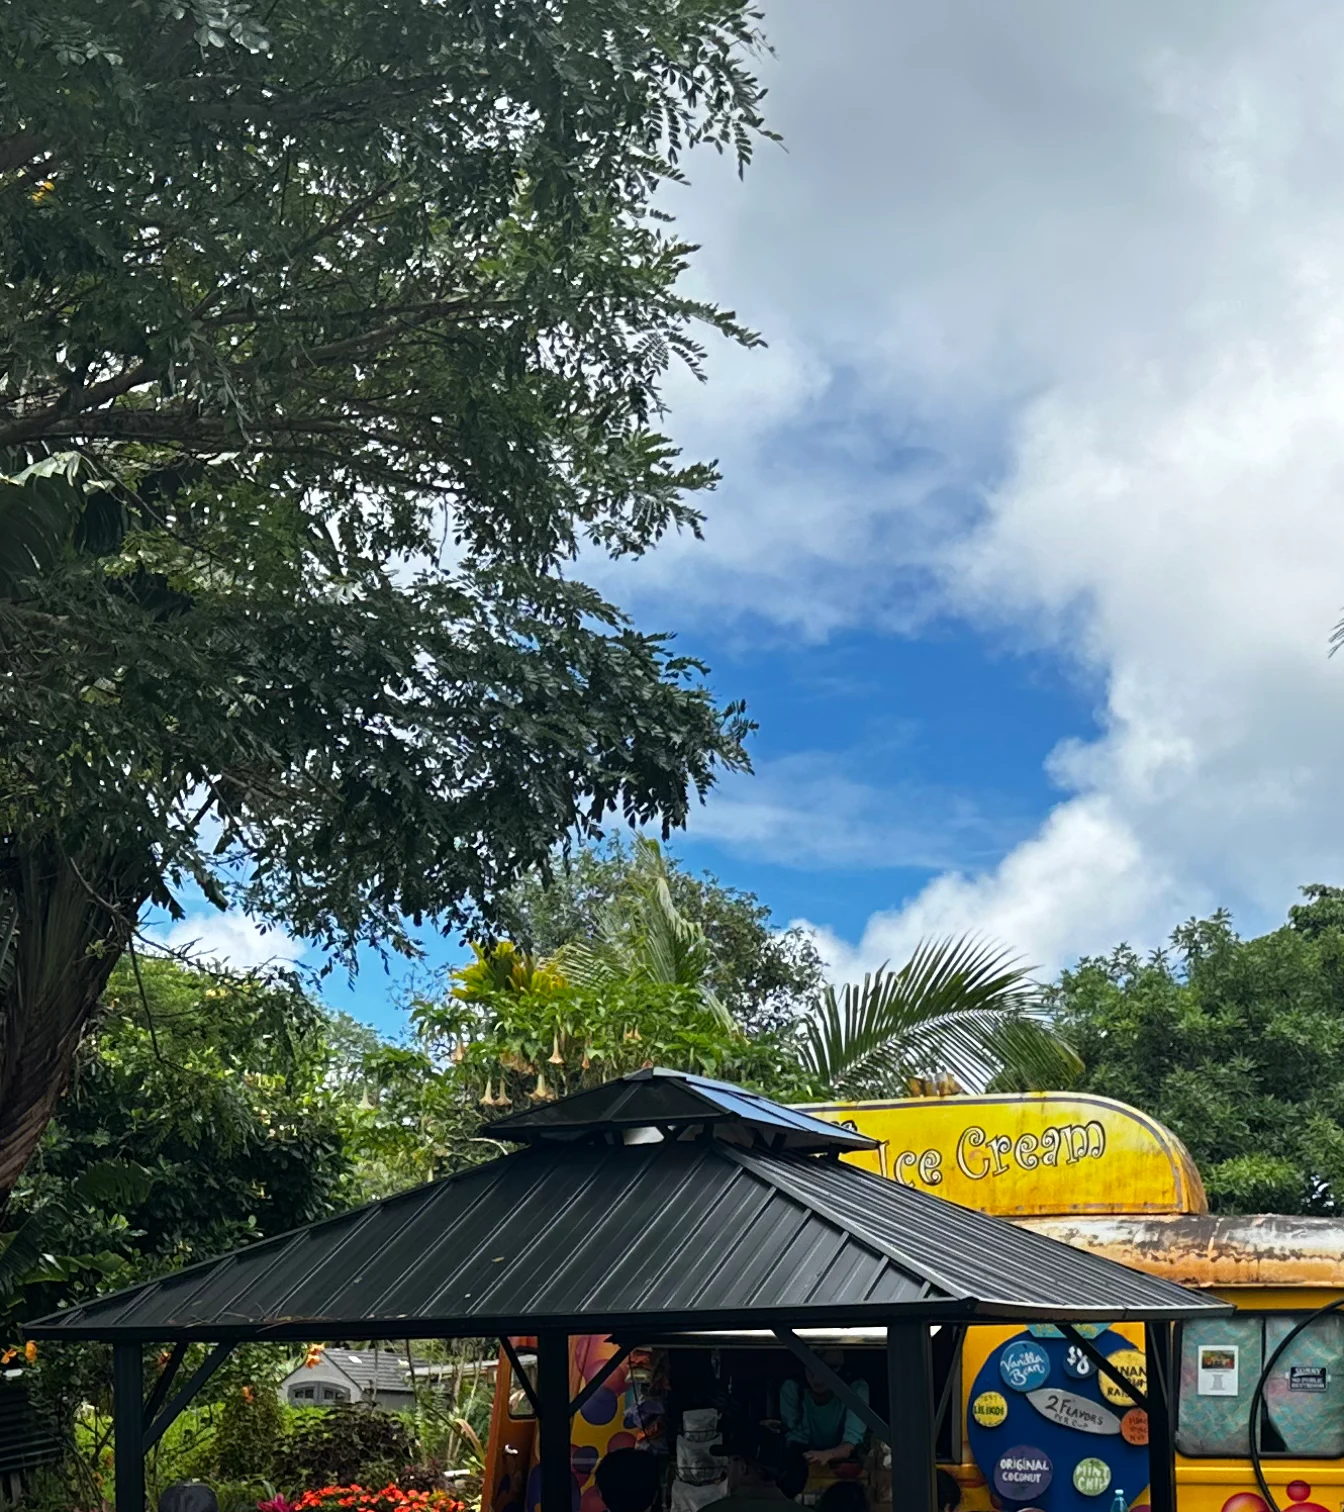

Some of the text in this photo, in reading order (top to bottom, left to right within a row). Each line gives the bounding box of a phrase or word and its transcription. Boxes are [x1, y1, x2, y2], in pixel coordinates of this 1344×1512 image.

[877, 1120, 1106, 1188] Ice Cream
[1000, 1352, 1044, 1372] Vanilla
[1009, 1364, 1045, 1386] Bean
[1045, 1395, 1103, 1425] 2 FLAVORS
[1000, 1456, 1049, 1471] ORIGINAL
[1076, 1464, 1108, 1478] MINT
[1002, 1471, 1042, 1484] COCONUT
[1077, 1476, 1108, 1491] CHIP
